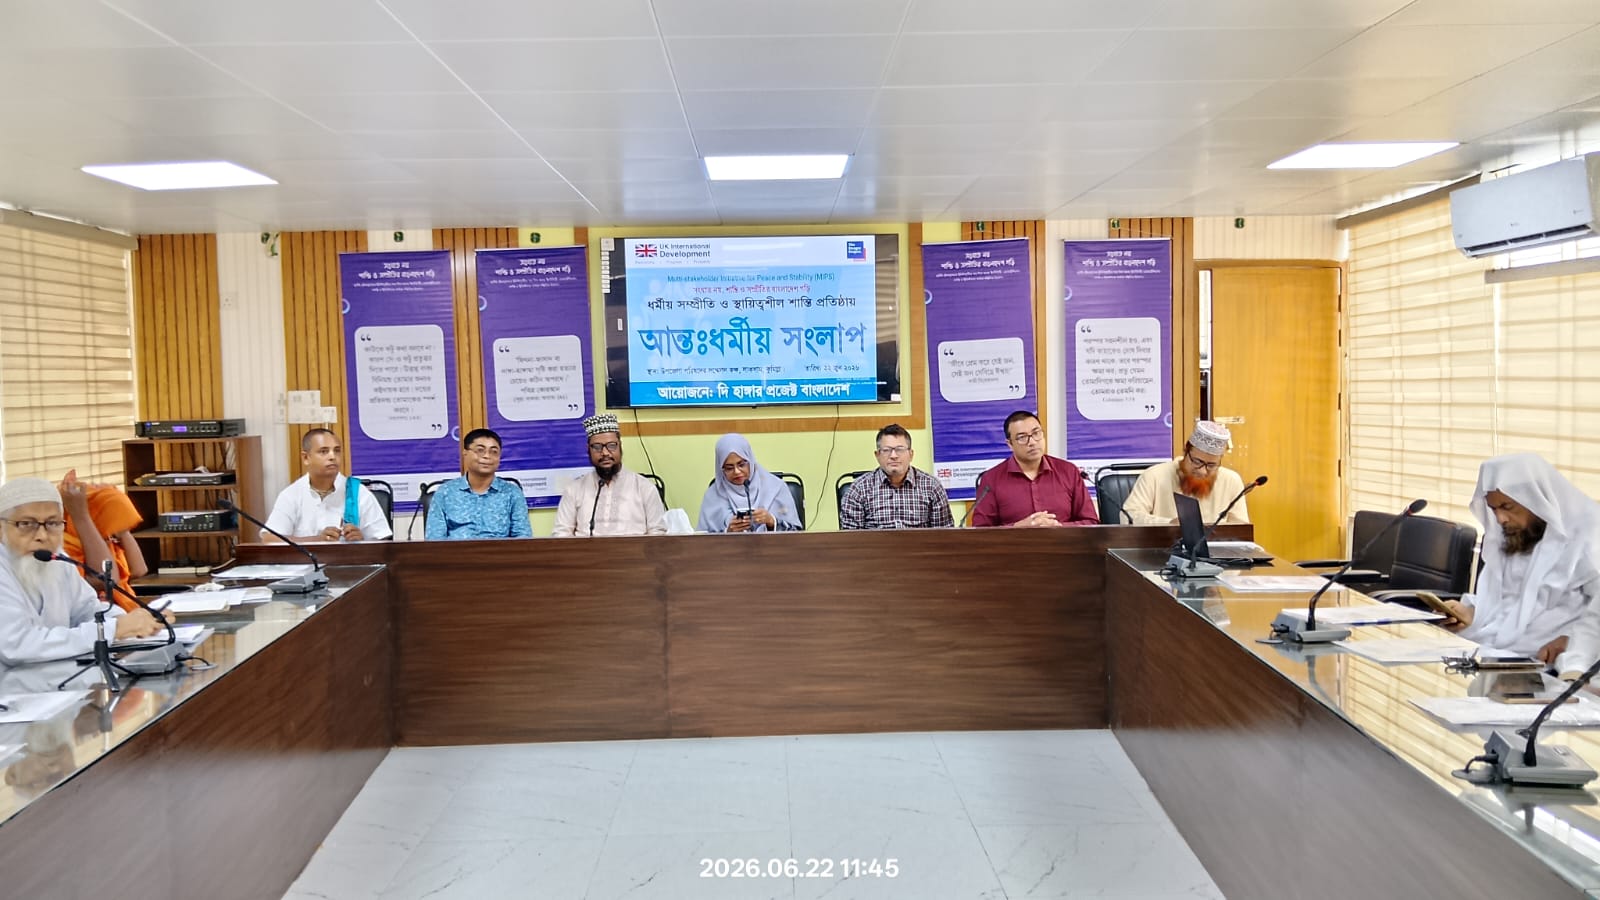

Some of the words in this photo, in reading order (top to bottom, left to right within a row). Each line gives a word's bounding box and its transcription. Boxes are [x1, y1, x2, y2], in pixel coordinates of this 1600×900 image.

[814, 272, 835, 281] (MIPS)
[648, 297, 673, 310] ধর্মীয়
[677, 296, 716, 310] সম্প্রীতি
[720, 300, 728, 308] ও
[732, 296, 784, 311] স্থায়িত্বশীল
[788, 296, 812, 308] শান্তি
[816, 294, 856, 308] প্রতিষ্ঠায়
[637, 316, 772, 357] আন্তঃধর্মীয়
[780, 322, 867, 356] সংলাপ
[717, 382, 730, 398] দি
[732, 385, 763, 399] হাঙ্গার
[766, 382, 798, 398] প্রজেক্ট
[800, 383, 850, 398] বাংলাদেশ
